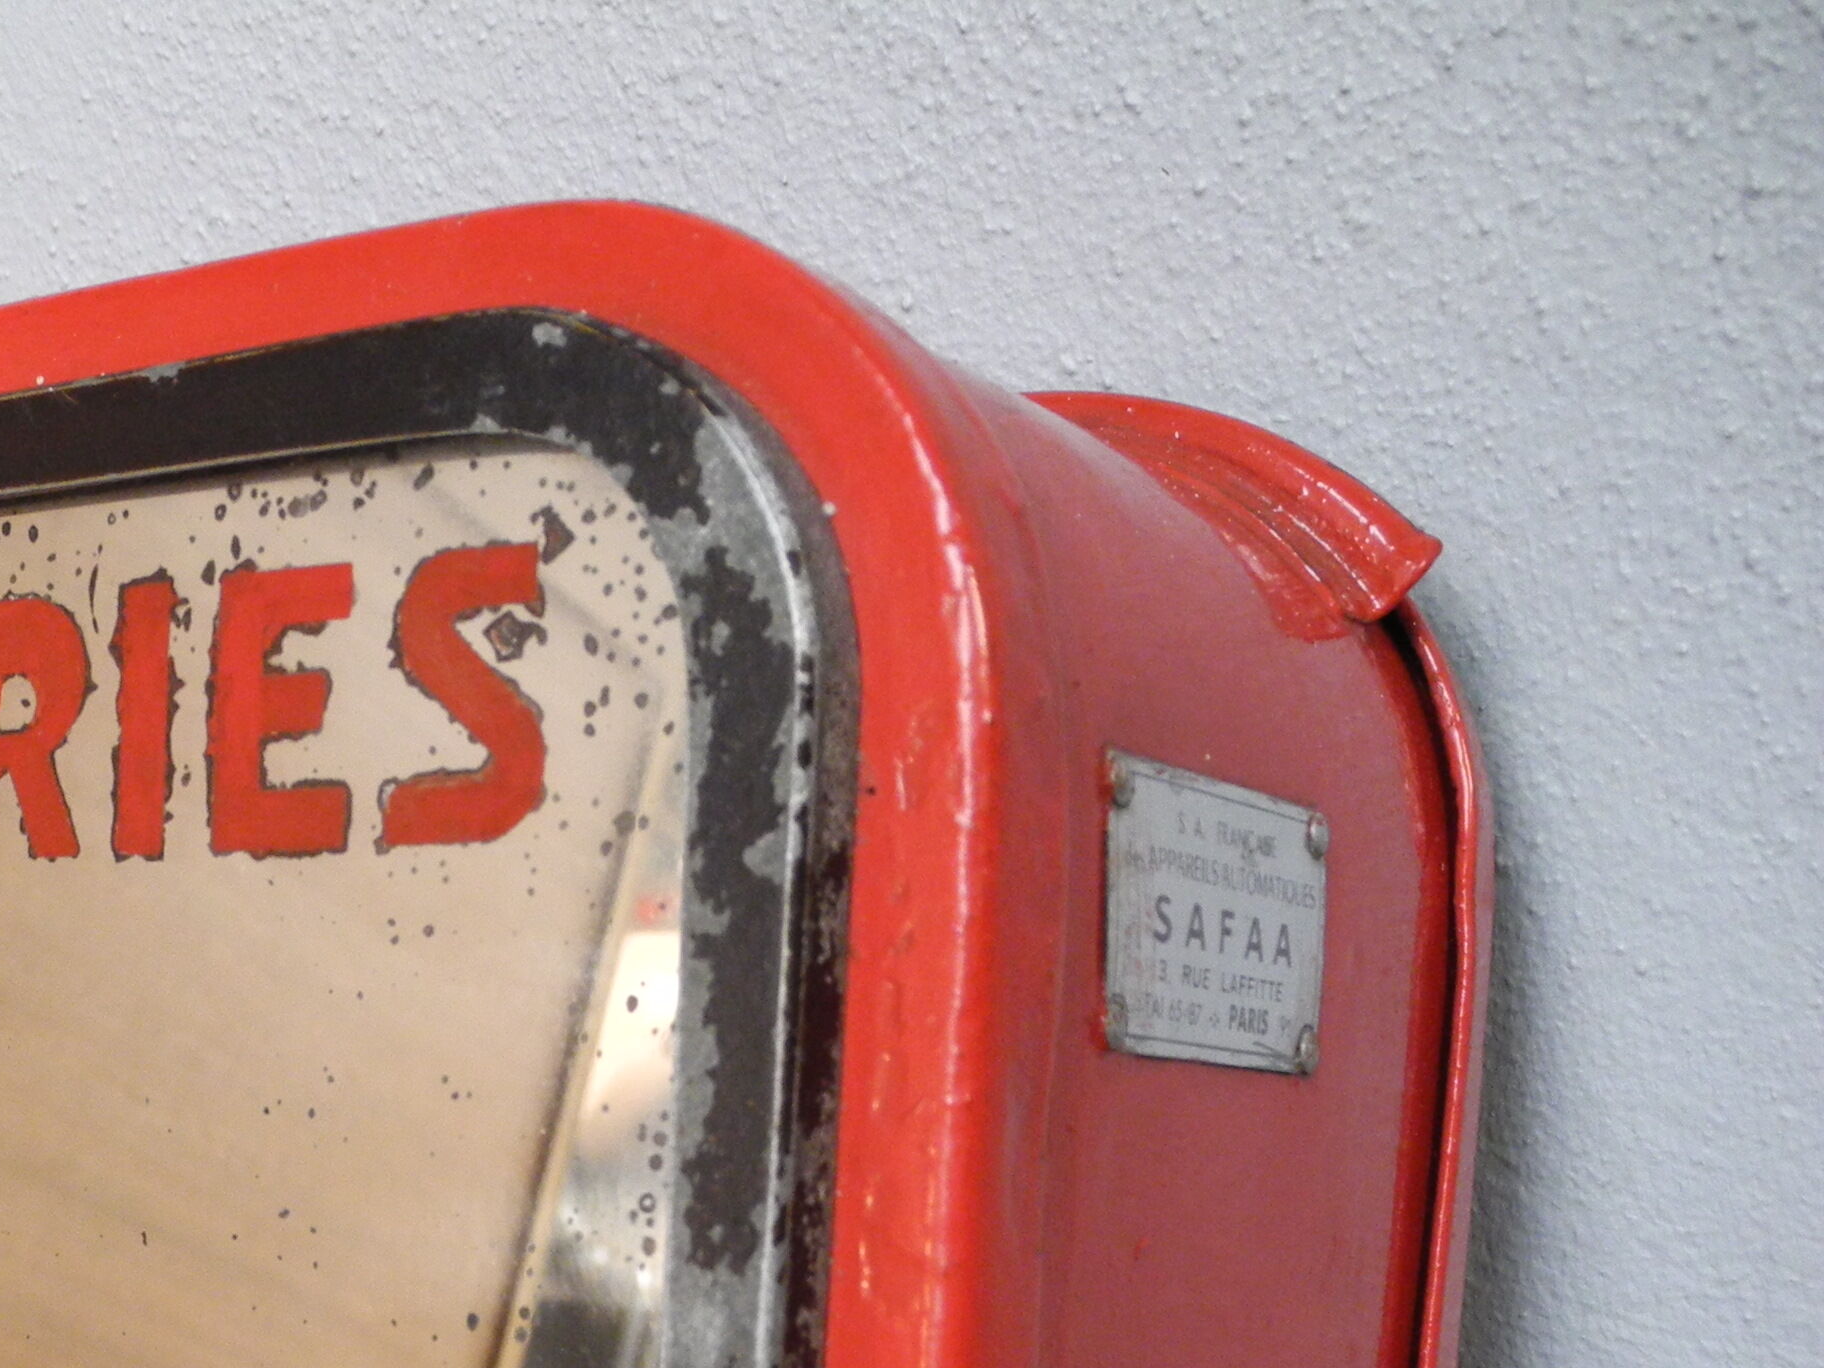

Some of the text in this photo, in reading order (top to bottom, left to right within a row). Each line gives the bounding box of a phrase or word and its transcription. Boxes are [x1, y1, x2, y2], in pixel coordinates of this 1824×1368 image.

[1153, 895, 1292, 968] SAFAA
[1182, 964, 1211, 990] RUE
[1221, 972, 1283, 1003] LAFFITTE
[1229, 1004, 1269, 1036] PARIS
